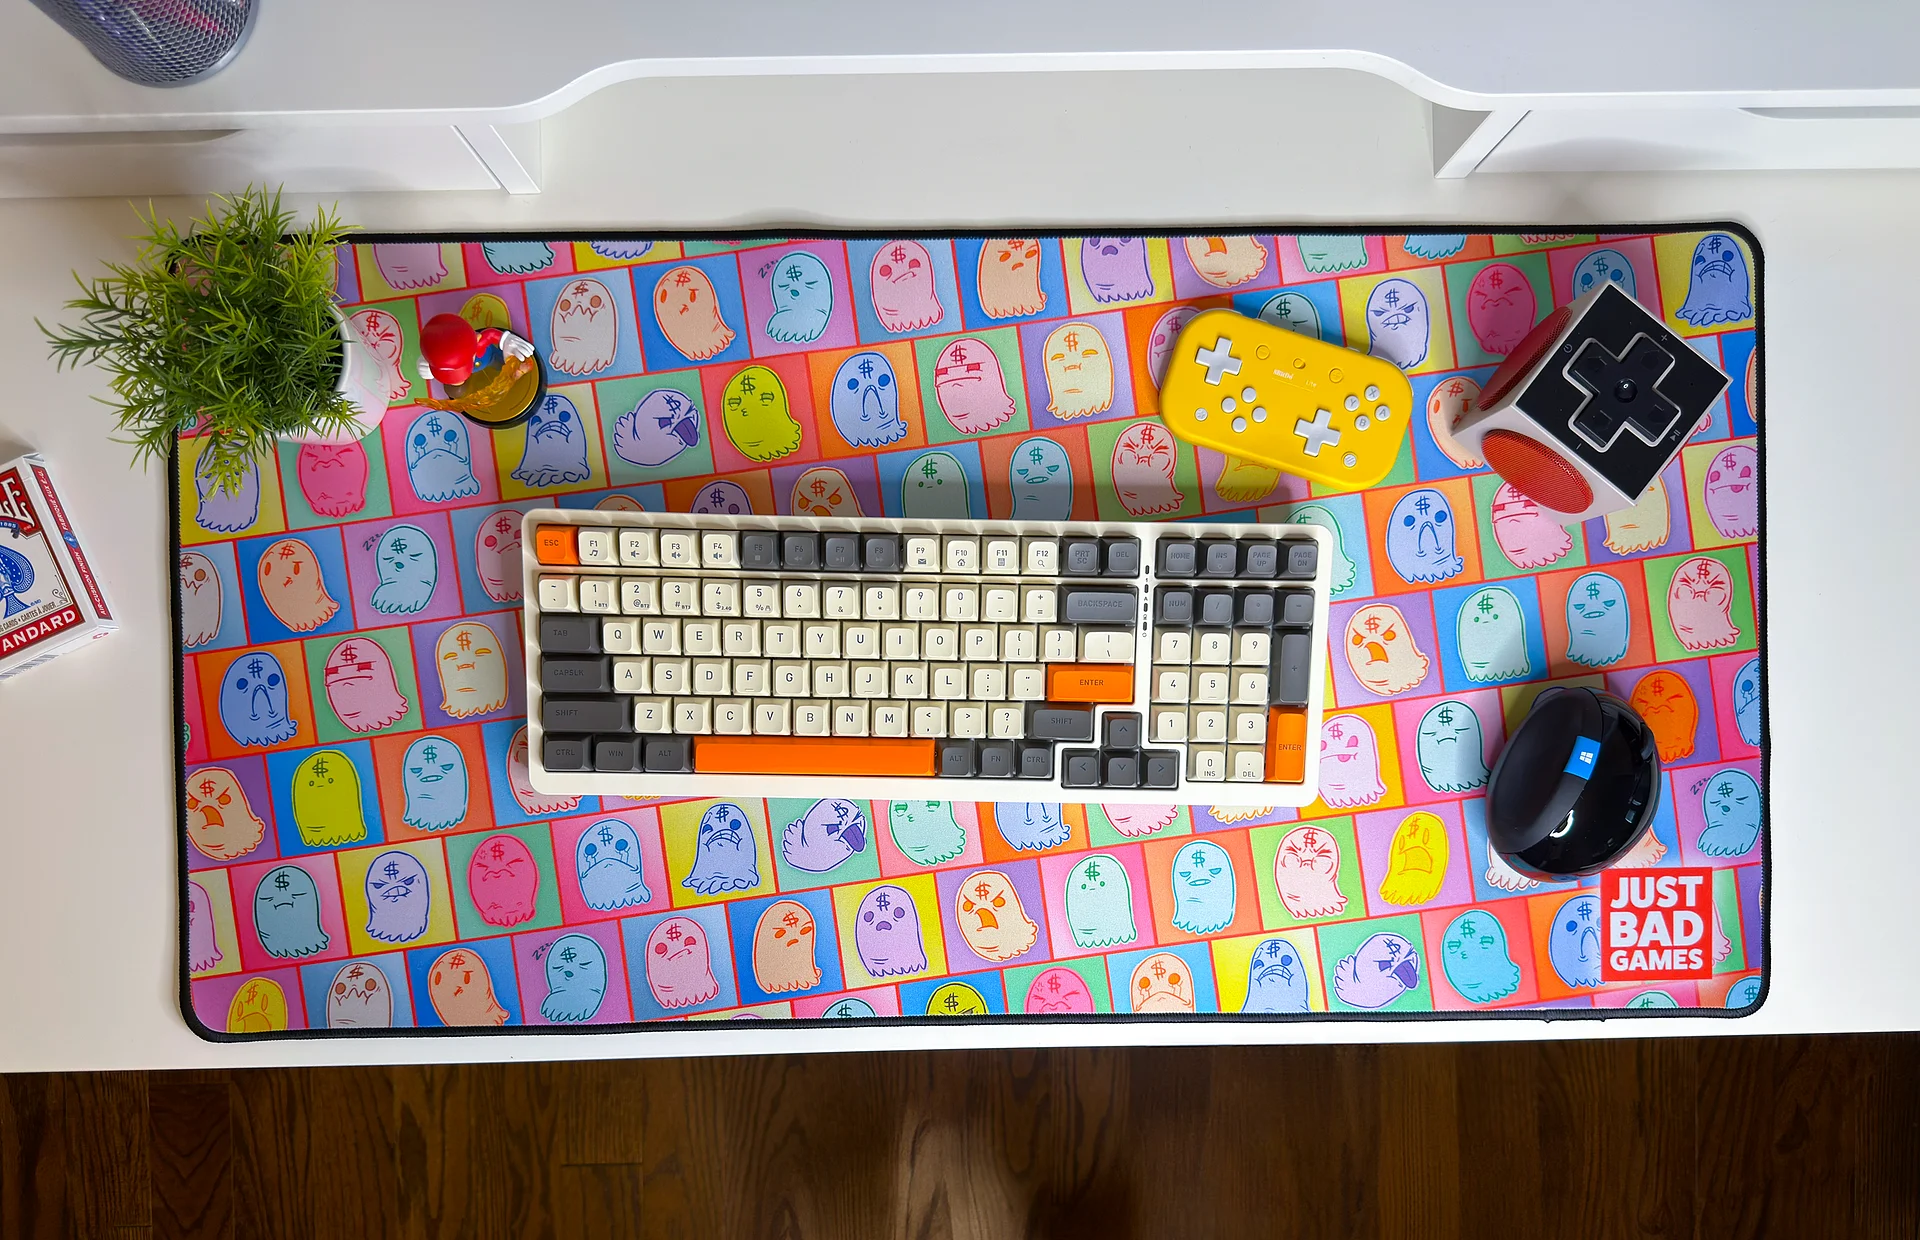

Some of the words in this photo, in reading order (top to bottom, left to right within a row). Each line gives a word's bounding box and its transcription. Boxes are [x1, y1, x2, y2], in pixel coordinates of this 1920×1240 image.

[1368, 388, 1377, 398] X
[1350, 398, 1357, 407] Y
[1379, 408, 1386, 417] A
[1359, 418, 1367, 427] B
[544, 539, 559, 547] ESC
[589, 539, 598, 547] F1
[630, 540, 639, 548] F2
[671, 542, 681, 550] F3
[713, 542, 722, 550] F4
[916, 546, 925, 554] F9
[956, 549, 968, 557] F10
[996, 549, 1008, 557] F11
[592, 584, 597, 593] 1
[633, 585, 640, 593] 2
[674, 585, 681, 593] 3
[715, 587, 721, 595] 4
[796, 589, 802, 597] 6
[756, 589, 762, 598] 5
[837, 590, 843, 598] 7
[877, 591, 883, 599] 8
[918, 592, 923, 600] 9
[958, 592, 963, 601] 0
[1077, 600, 1123, 608] BACKSPACE
[20, 610, 38, 622] CARTES
[614, 629, 622, 640] Q
[653, 629, 665, 640] W
[696, 631, 703, 641] E
[735, 631, 742, 641] R
[776, 632, 784, 642] T
[817, 632, 824, 642] Y
[857, 634, 863, 644] U
[898, 635, 901, 645] I
[936, 635, 944, 645] O
[976, 635, 983, 645] P
[1172, 640, 1178, 649] 7
[1212, 641, 1218, 649] 8
[1252, 641, 1258, 649] 9
[625, 669, 633, 679] A
[666, 670, 673, 680] S
[706, 671, 713, 680] D
[747, 672, 753, 680] F
[786, 672, 793, 682] G
[826, 673, 833, 682] H
[865, 674, 872, 683] J
[906, 674, 914, 684] K
[946, 676, 952, 685] L
[1170, 680, 1176, 688] 4
[1210, 680, 1216, 688] 5
[1250, 681, 1256, 689] 6
[646, 710, 653, 719] Z
[686, 711, 693, 720] X
[726, 711, 734, 721] C
[766, 712, 774, 721] V
[807, 713, 813, 722] B
[846, 713, 854, 722] N
[885, 713, 894, 723] M
[1051, 717, 1073, 725] SHIFT
[1169, 719, 1173, 727] 1
[1208, 719, 1213, 728] 2
[1248, 720, 1254, 729] 3
[991, 755, 1001, 763] FN
[1026, 755, 1045, 763] CTRL
[1207, 759, 1213, 767] 0
[1610, 875, 1704, 909] JUST
[1610, 910, 1704, 948] BAD
[1610, 948, 1704, 972] GAMES
